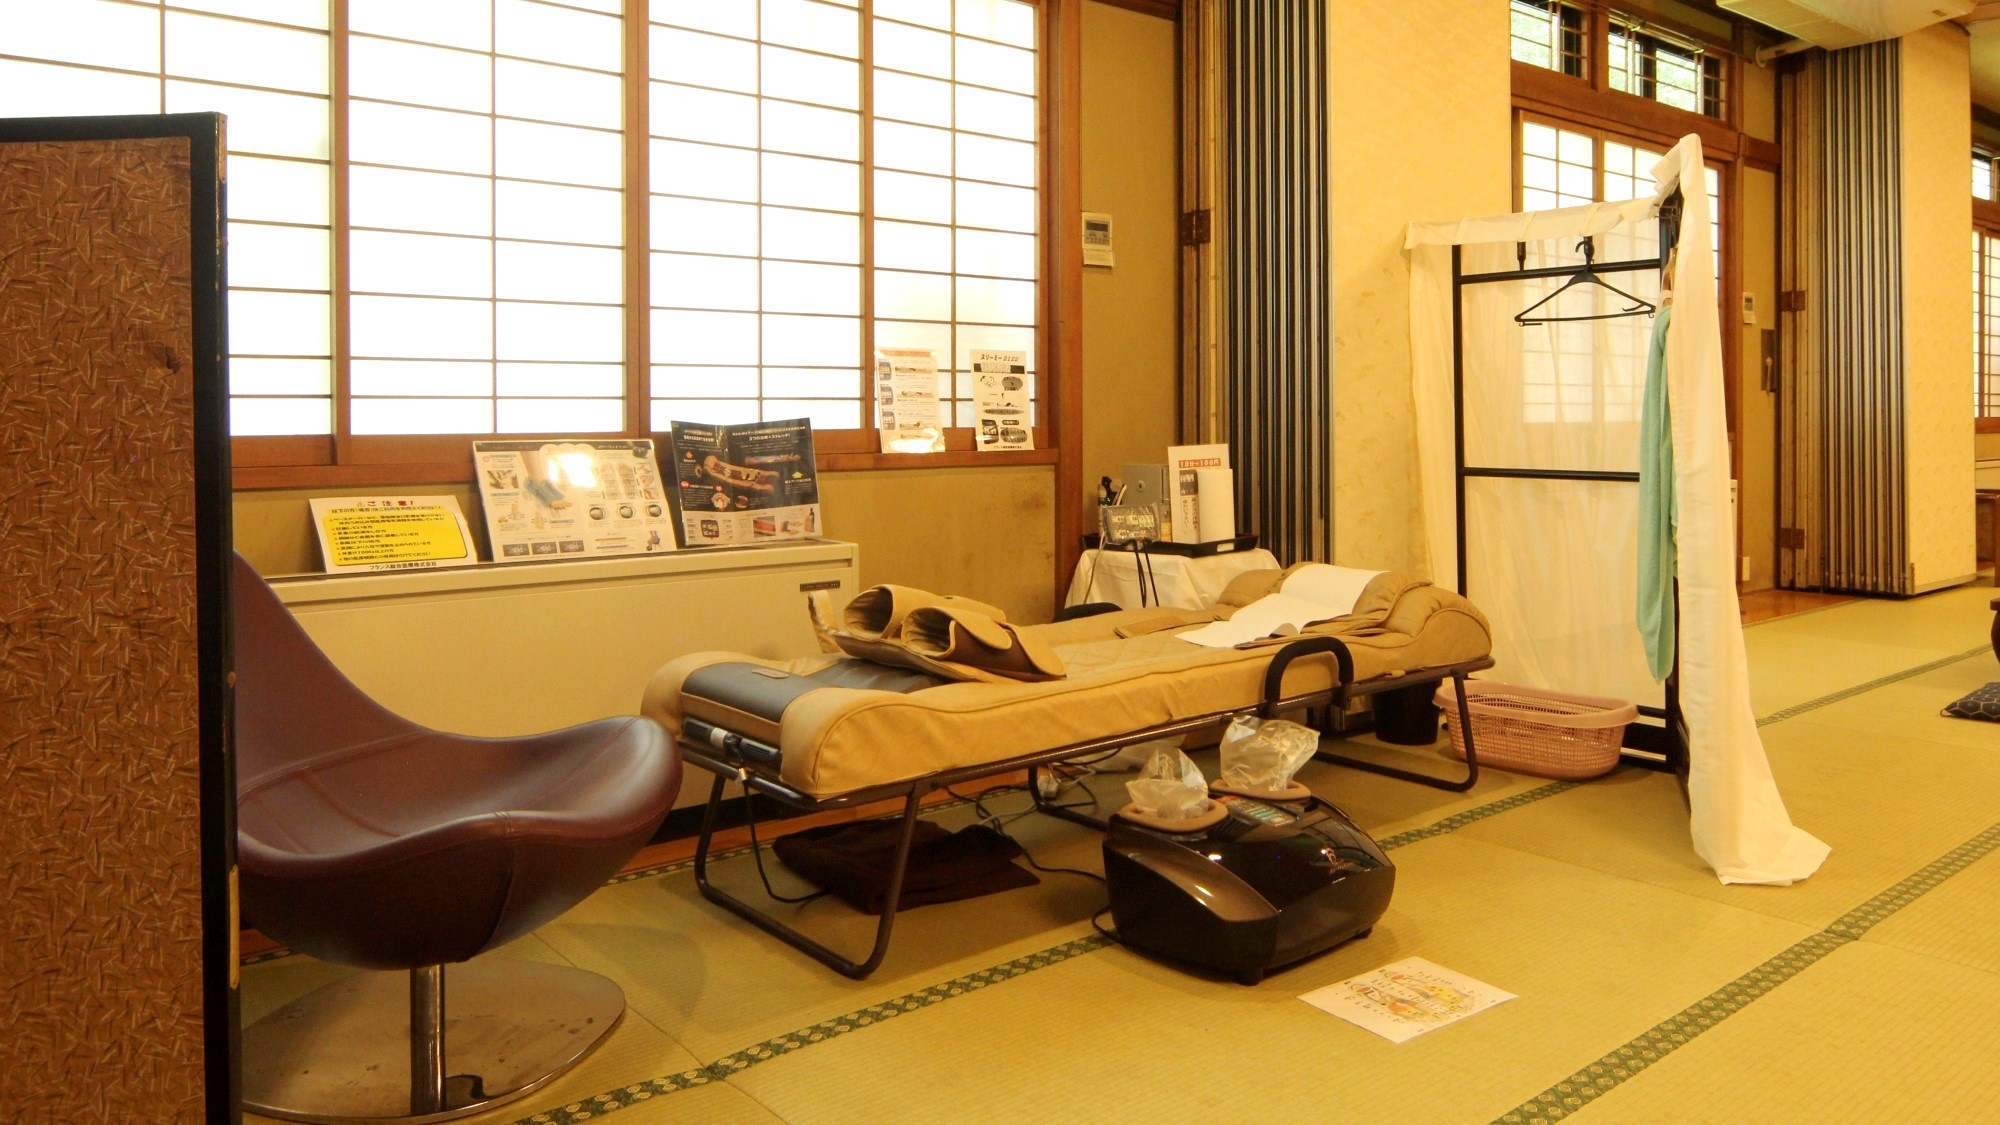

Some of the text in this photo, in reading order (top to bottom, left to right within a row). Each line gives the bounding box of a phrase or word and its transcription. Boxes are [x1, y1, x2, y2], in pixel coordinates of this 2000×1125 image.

[370, 562, 437, 570] フランス総合医療株式会社
